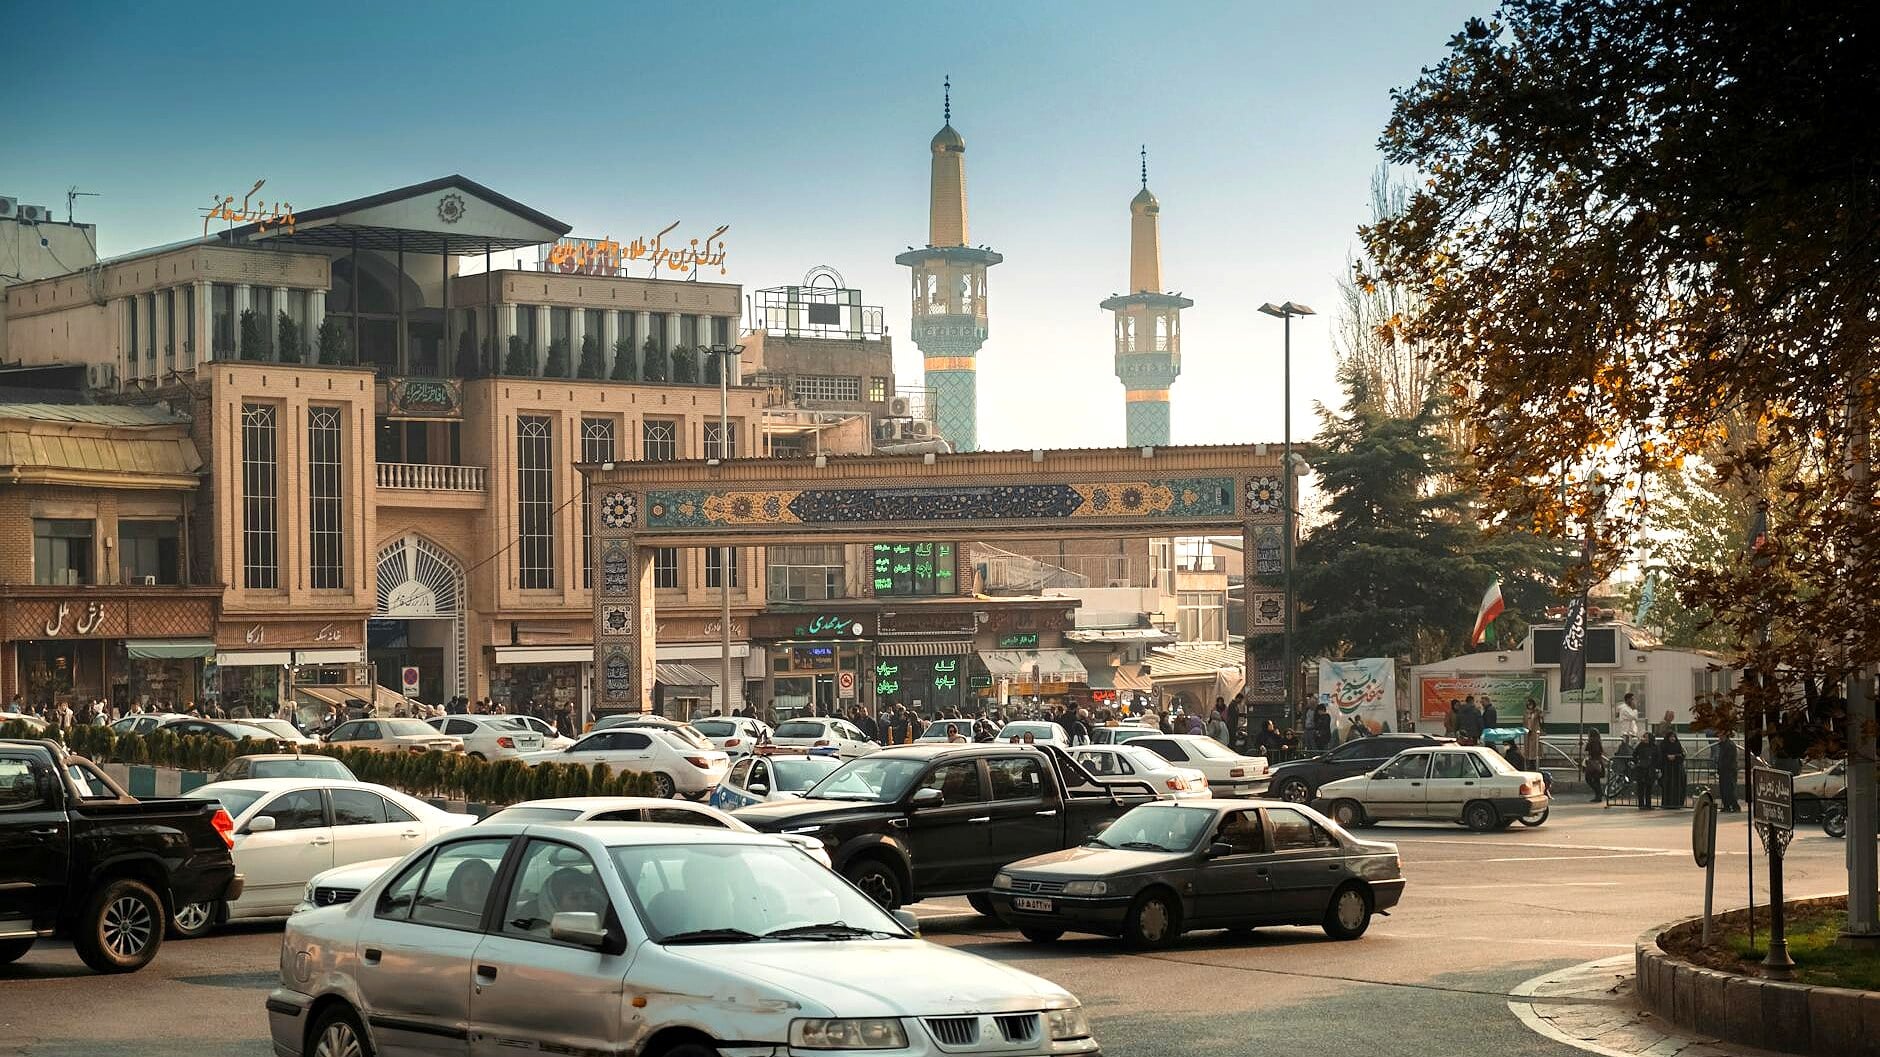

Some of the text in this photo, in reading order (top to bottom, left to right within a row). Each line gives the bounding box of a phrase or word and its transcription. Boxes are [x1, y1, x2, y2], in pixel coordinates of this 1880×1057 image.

[231, 179, 267, 234] بزرگ
[267, 202, 297, 238] بازار
[629, 236, 646, 260] طلا
[650, 220, 680, 267] مرکز
[46, 600, 104, 637] فرش ملل
[809, 615, 838, 634] مهدی
[834, 619, 852, 635] سید
[934, 660, 956, 672] کله
[934, 674, 956, 690] پاچه
[1330, 681, 1385, 708] هفته
[1339, 672, 1377, 714] بسیج
[1756, 776, 1790, 801] میدان تجریش
